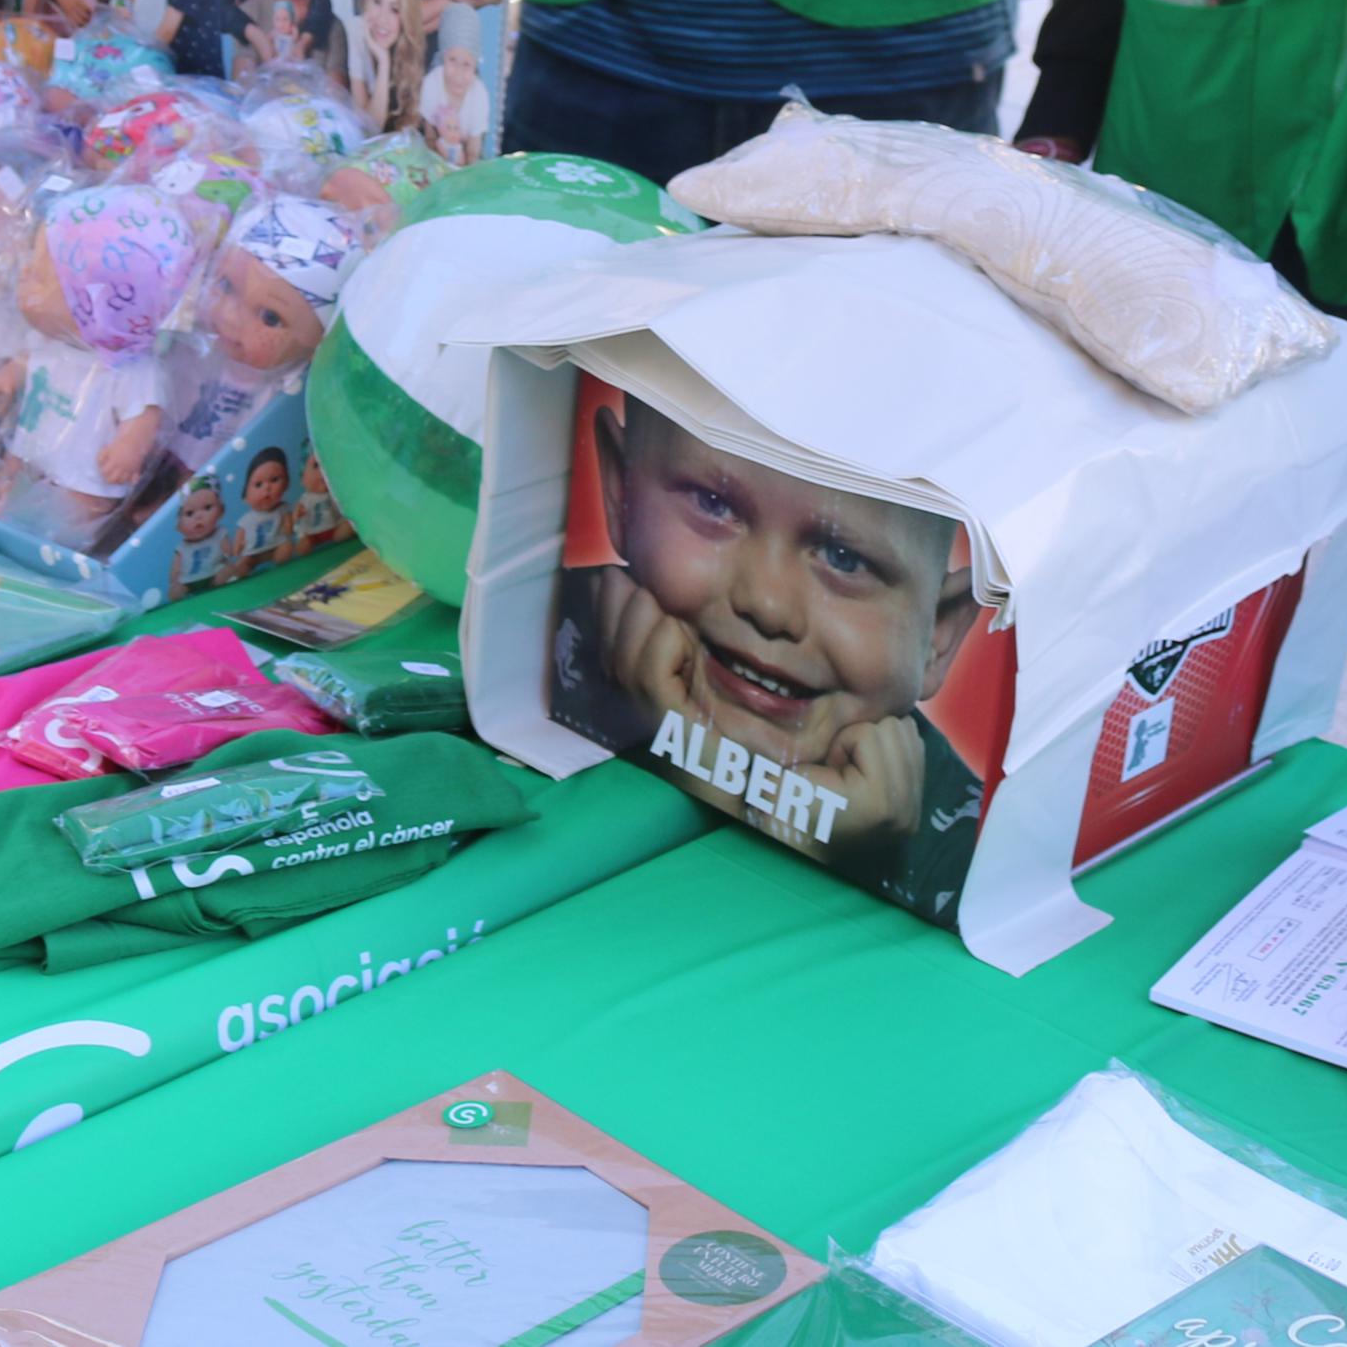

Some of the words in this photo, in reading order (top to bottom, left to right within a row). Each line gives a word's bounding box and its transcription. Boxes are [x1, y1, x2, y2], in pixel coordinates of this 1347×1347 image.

[650, 709, 848, 844] ALBERT
[272, 842, 350, 869] contra
[355, 831, 375, 852] el
[1289, 973, 1339, 1016] 63.967
[364, 1245, 444, 1311] than
[397, 1220, 497, 1287] better
